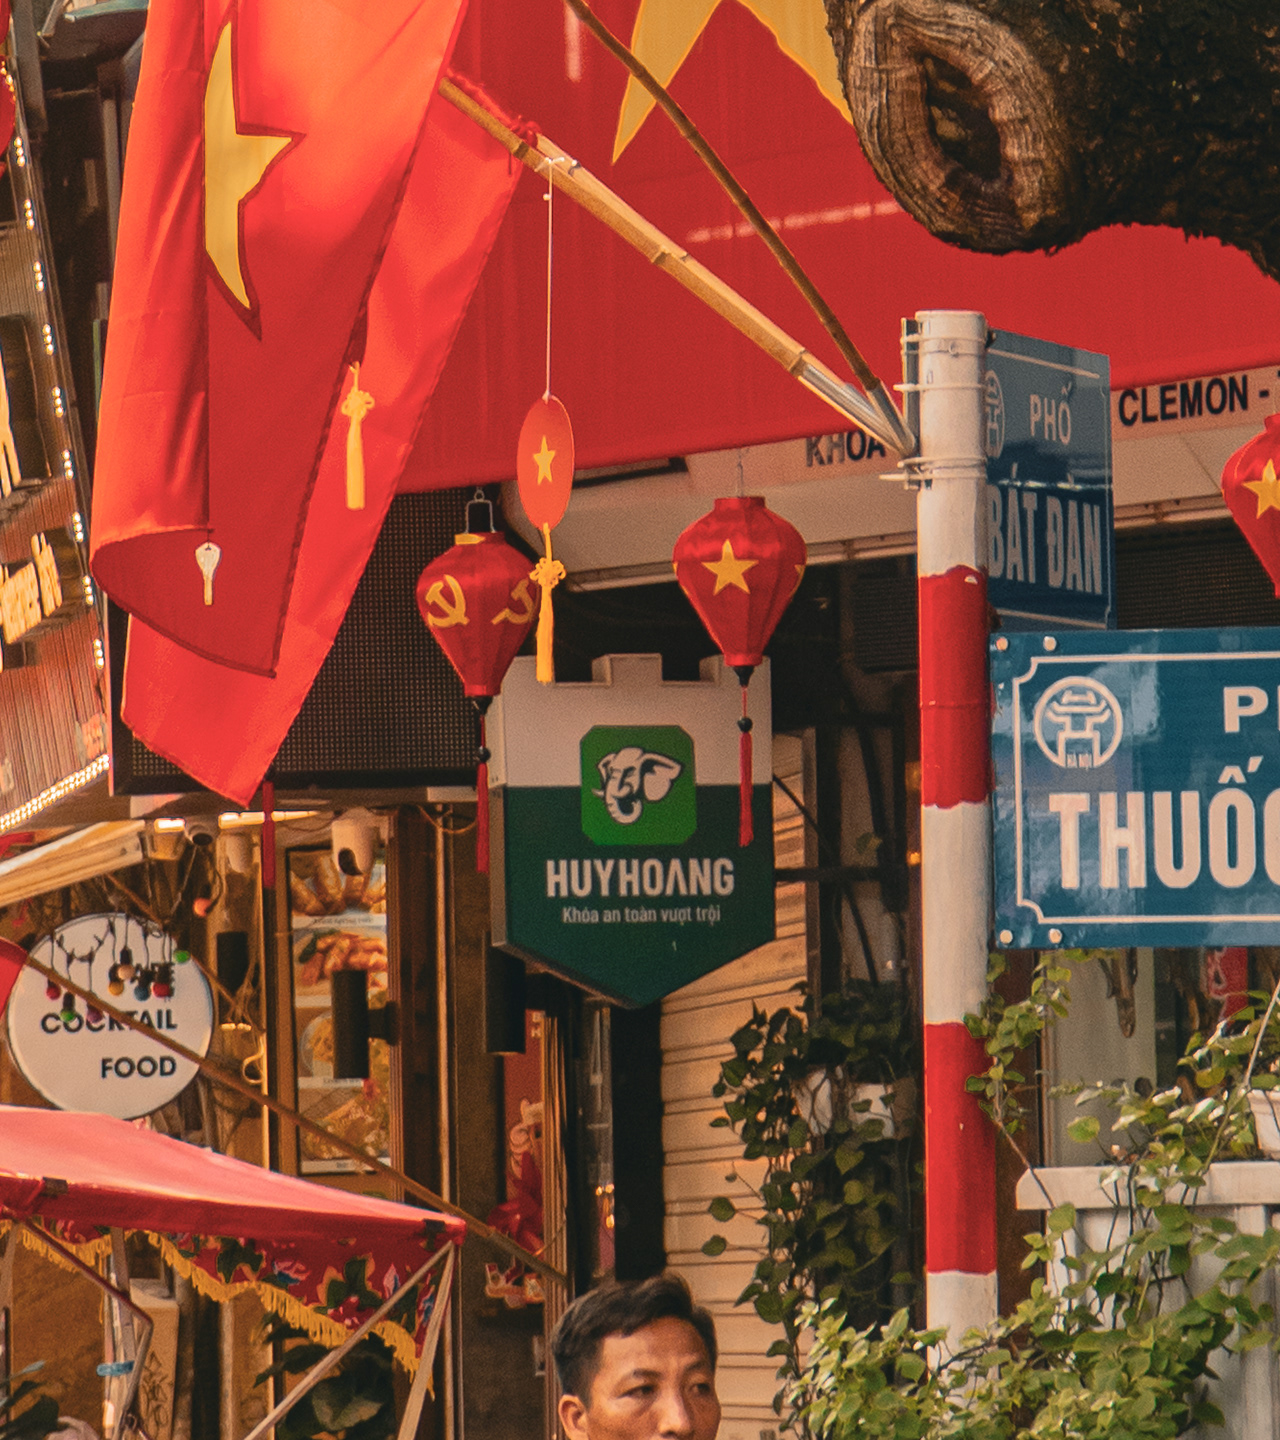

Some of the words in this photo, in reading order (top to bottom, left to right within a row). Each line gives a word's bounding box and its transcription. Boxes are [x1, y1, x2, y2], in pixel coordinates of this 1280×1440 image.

[1030, 381, 1075, 446] PHỐ
[1119, 376, 1249, 427] CLEMON
[988, 463, 1038, 584] BÁT
[603, 908, 621, 922] an
[101, 1055, 177, 1079] FOOD
